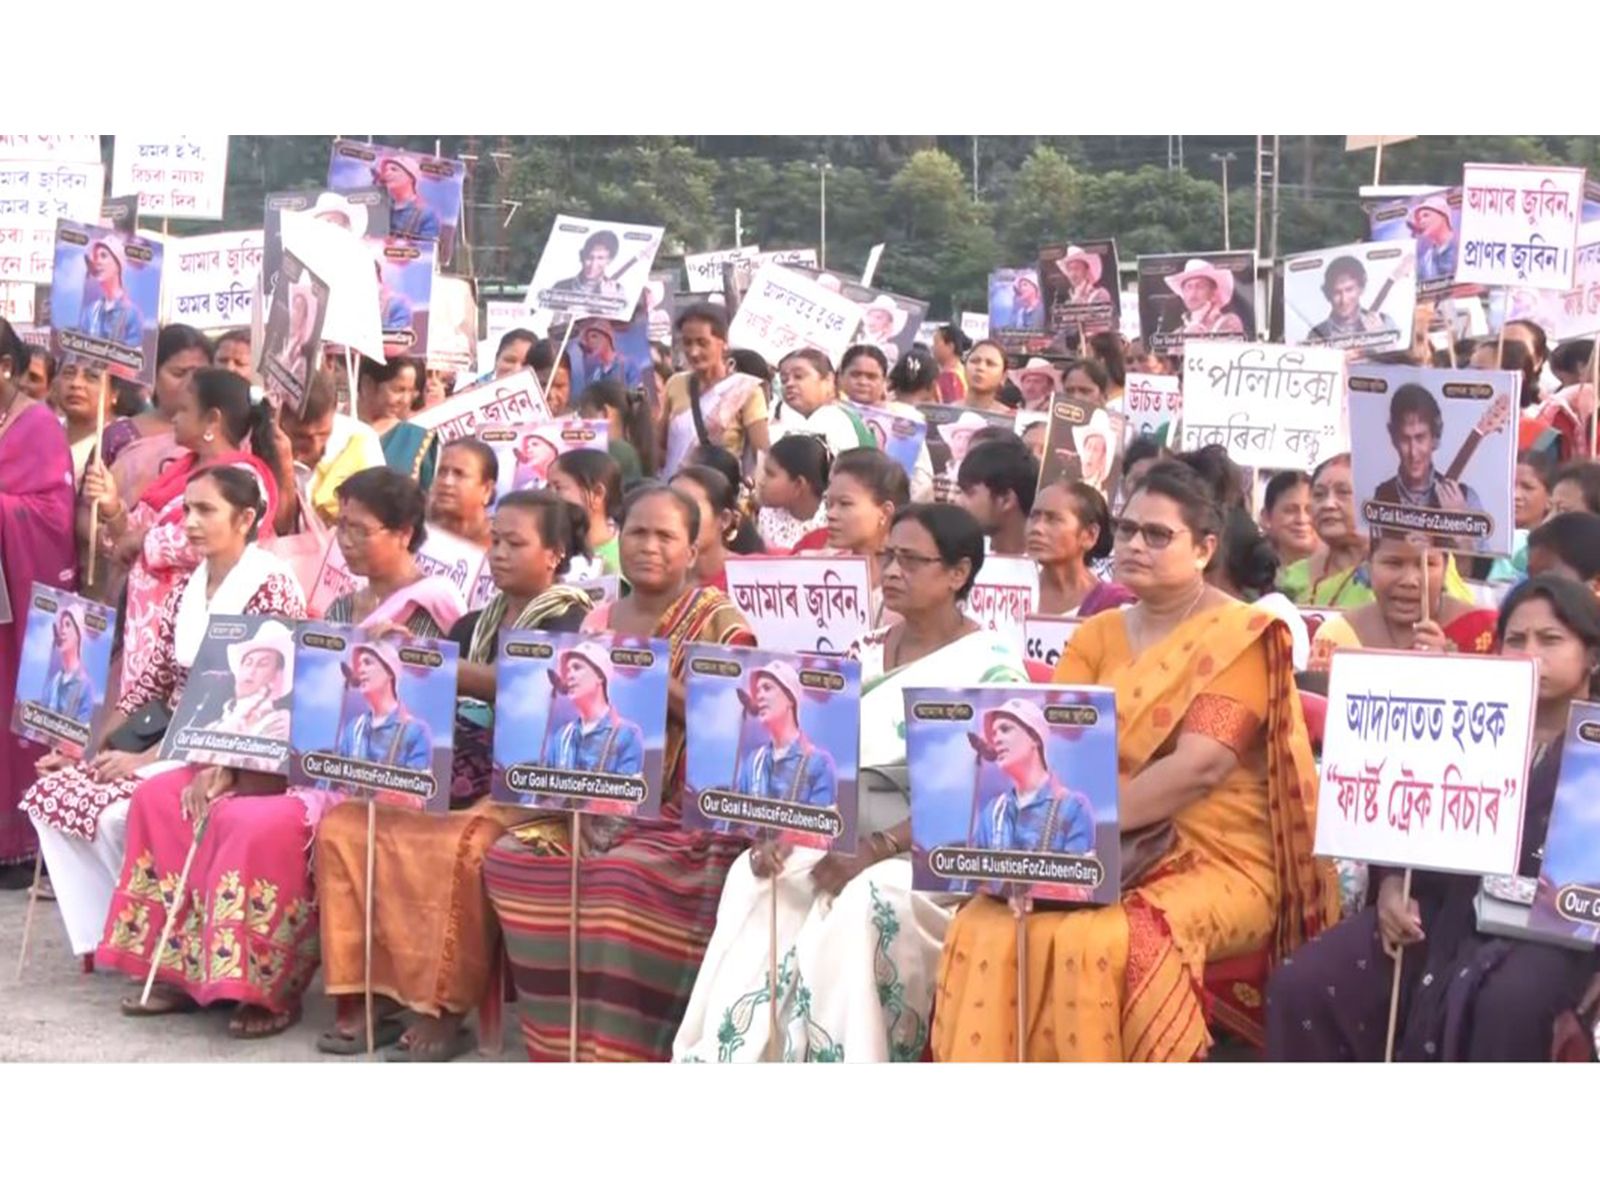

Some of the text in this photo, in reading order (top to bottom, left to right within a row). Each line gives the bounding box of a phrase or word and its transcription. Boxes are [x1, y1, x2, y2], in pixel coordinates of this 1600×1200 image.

[1467, 178, 1574, 225] আমাৰ জুবিন,
[1464, 239, 1507, 269] প্ৰাণৰ
[1129, 380, 1163, 411] উচিত
[733, 569, 866, 629] আমাৰ জুবিন,
[1346, 688, 1509, 753] আদালতত হওক
[307, 757, 432, 796] Our Goal #JusticeForZubeenGarg
[512, 771, 643, 802] Our Goal #JusticeForZubeenGarg
[704, 795, 838, 837] Our Goal #JusticeForZubeenGarg
[936, 852, 1098, 885] Our Goal #JusticeForZubeenGarg
[1565, 891, 1590, 913] Our
